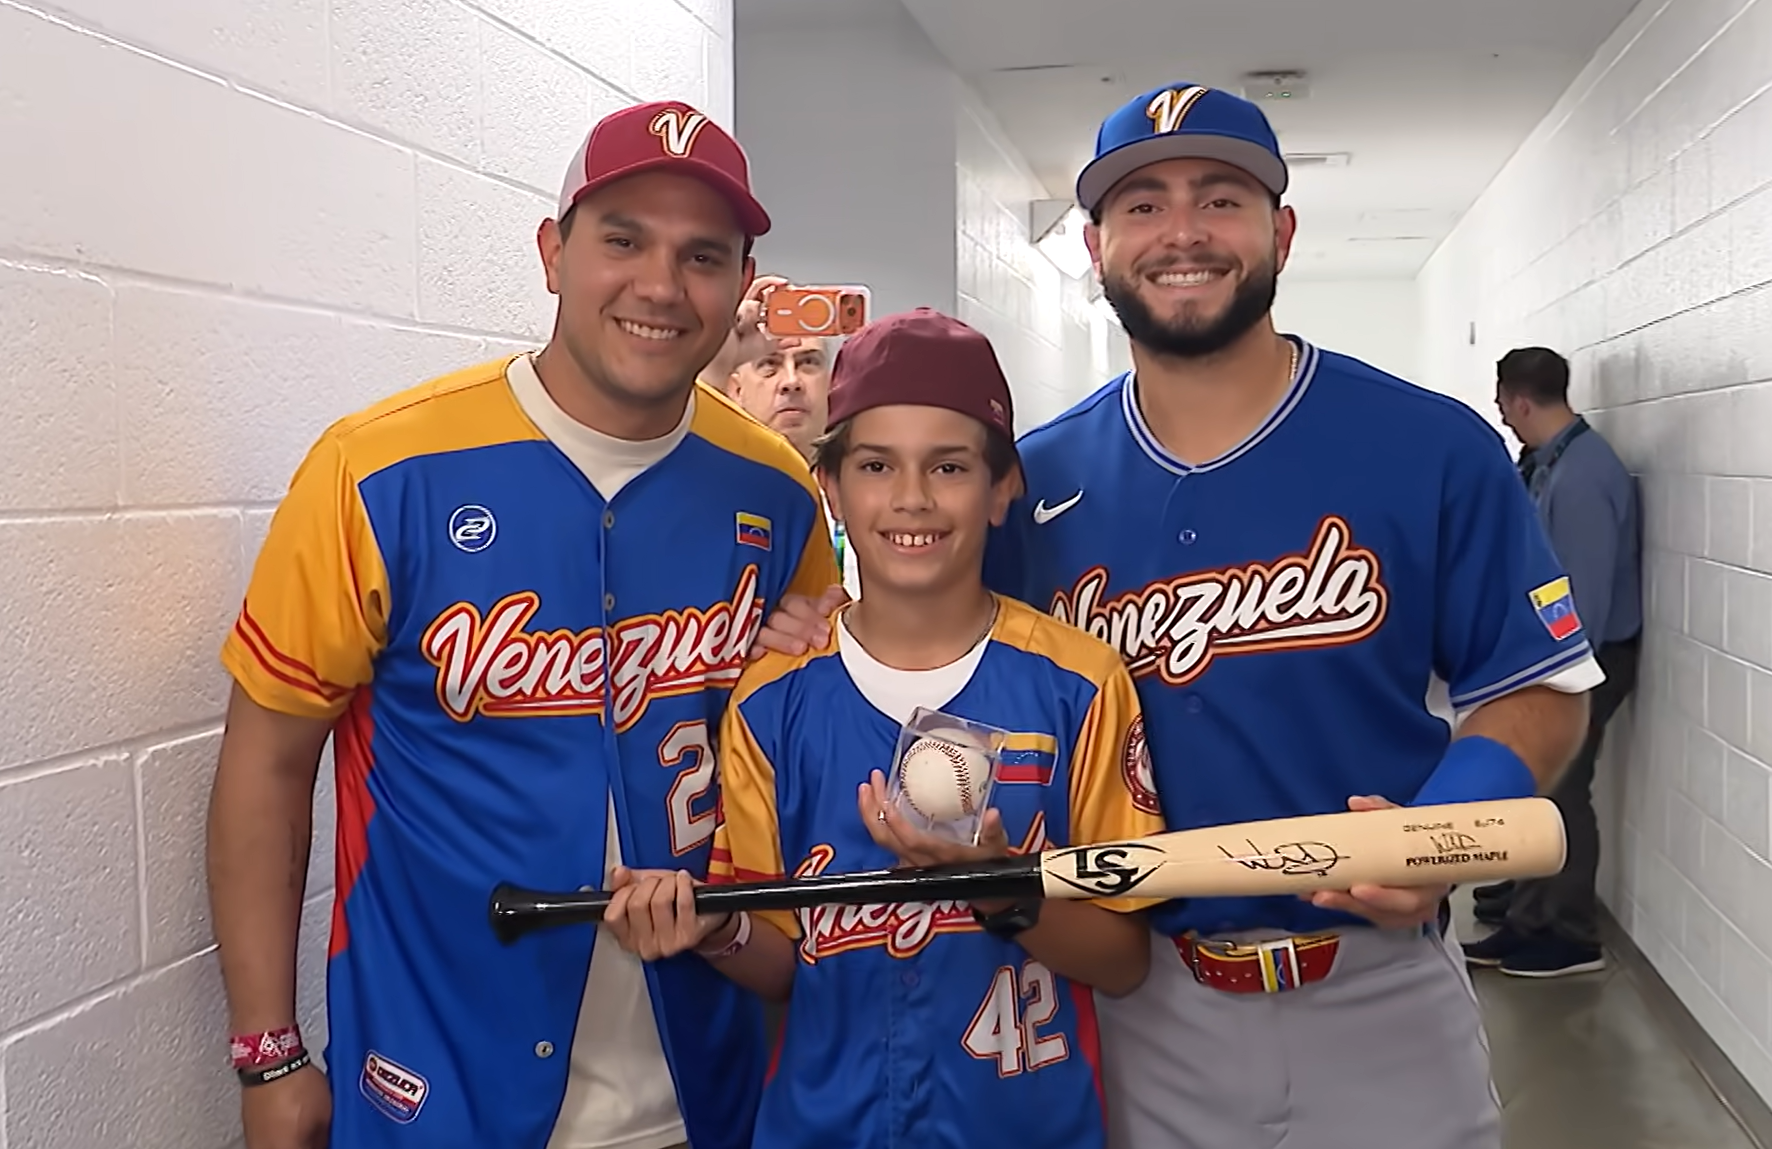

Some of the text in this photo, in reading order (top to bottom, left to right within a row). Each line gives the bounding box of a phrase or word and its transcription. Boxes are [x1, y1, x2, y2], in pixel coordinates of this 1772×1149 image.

[649, 109, 709, 158] V
[1147, 86, 1210, 134] V
[961, 959, 1070, 1078] 42
